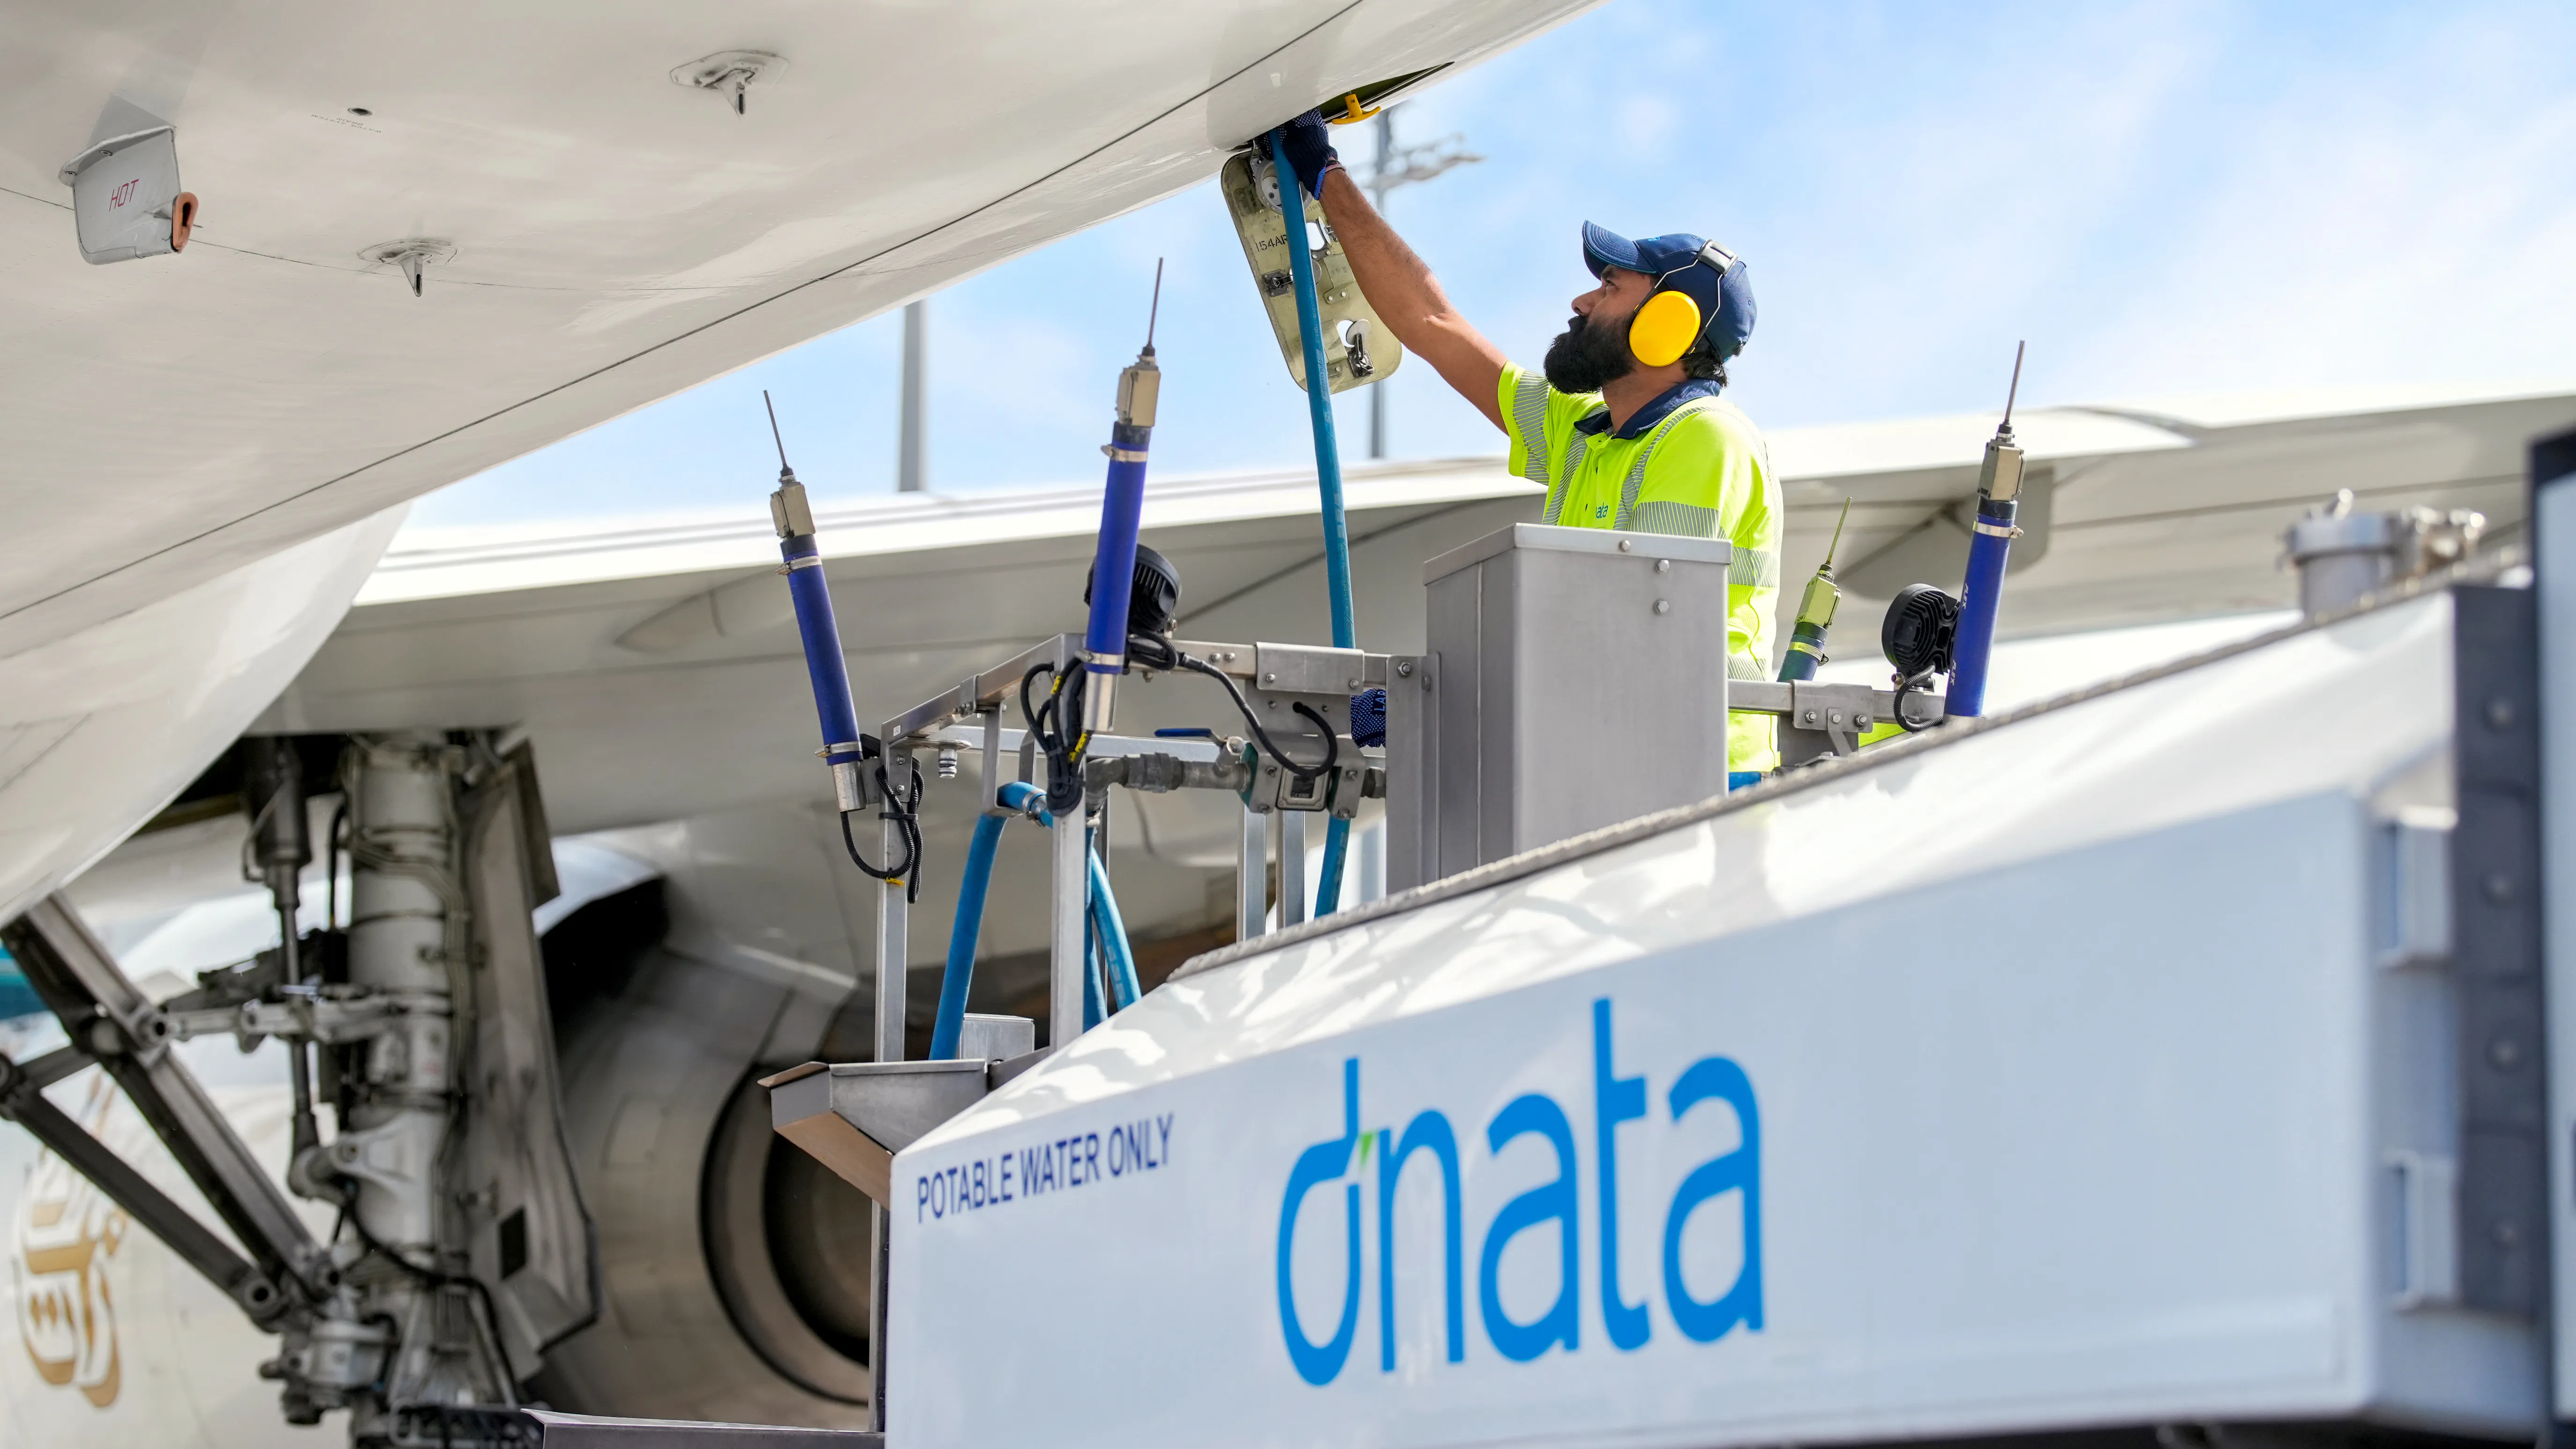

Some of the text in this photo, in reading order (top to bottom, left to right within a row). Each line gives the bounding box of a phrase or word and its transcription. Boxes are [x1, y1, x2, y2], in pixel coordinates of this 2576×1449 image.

[311, 114, 381, 133] WATER SYSTEM
[109, 178, 139, 212] HOT
[1596, 502, 1608, 519] ata
[918, 1110, 1174, 1224] POTABLE WATER ONLY
[1277, 996, 1763, 1386] dnata
